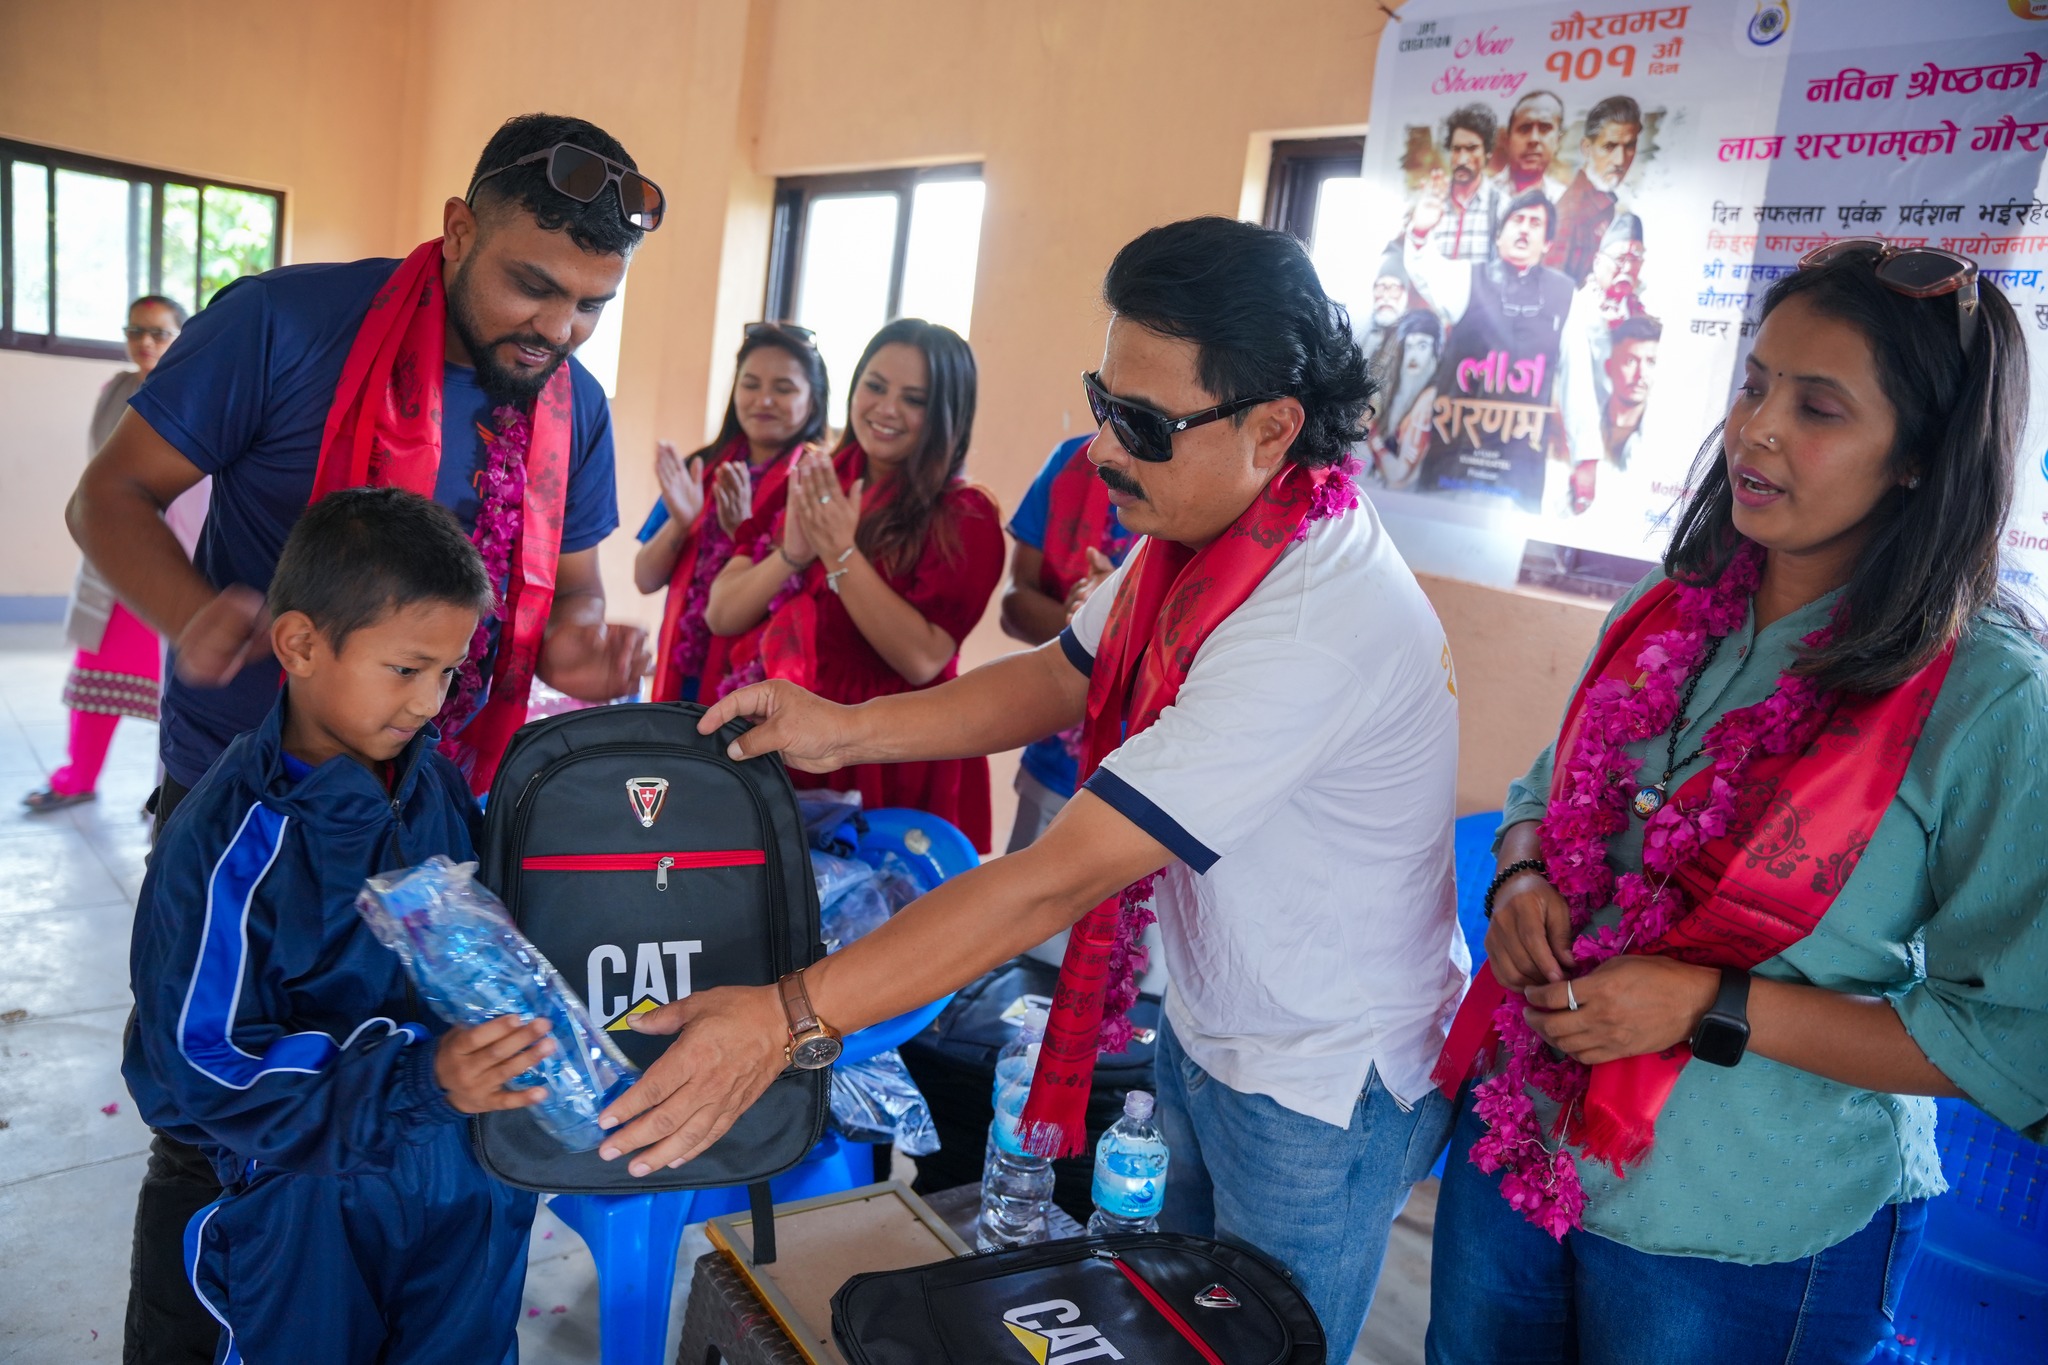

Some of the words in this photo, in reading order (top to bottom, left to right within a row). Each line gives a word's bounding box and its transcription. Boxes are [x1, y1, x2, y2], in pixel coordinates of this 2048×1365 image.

[1454, 25, 1515, 59] Now
[1550, 5, 1692, 42] गौरवमय
[1431, 65, 1529, 98] Showing
[1545, 44, 1636, 83] १०१
[1806, 67, 1899, 103] नविन
[1906, 51, 2048, 99] श्रेष्ठको
[1717, 136, 1786, 163] लाज
[1795, 120, 1962, 161] शरणम्को
[1970, 114, 2048, 153] गौर
[1711, 200, 1742, 225] दिन
[1838, 199, 1887, 229] पूर्वक
[1703, 258, 1724, 280] श्री
[1690, 319, 1731, 340] वाटर
[1456, 349, 1546, 398] लाज
[587, 940, 702, 1030] CAT
[1003, 1299, 1125, 1365] CAT
